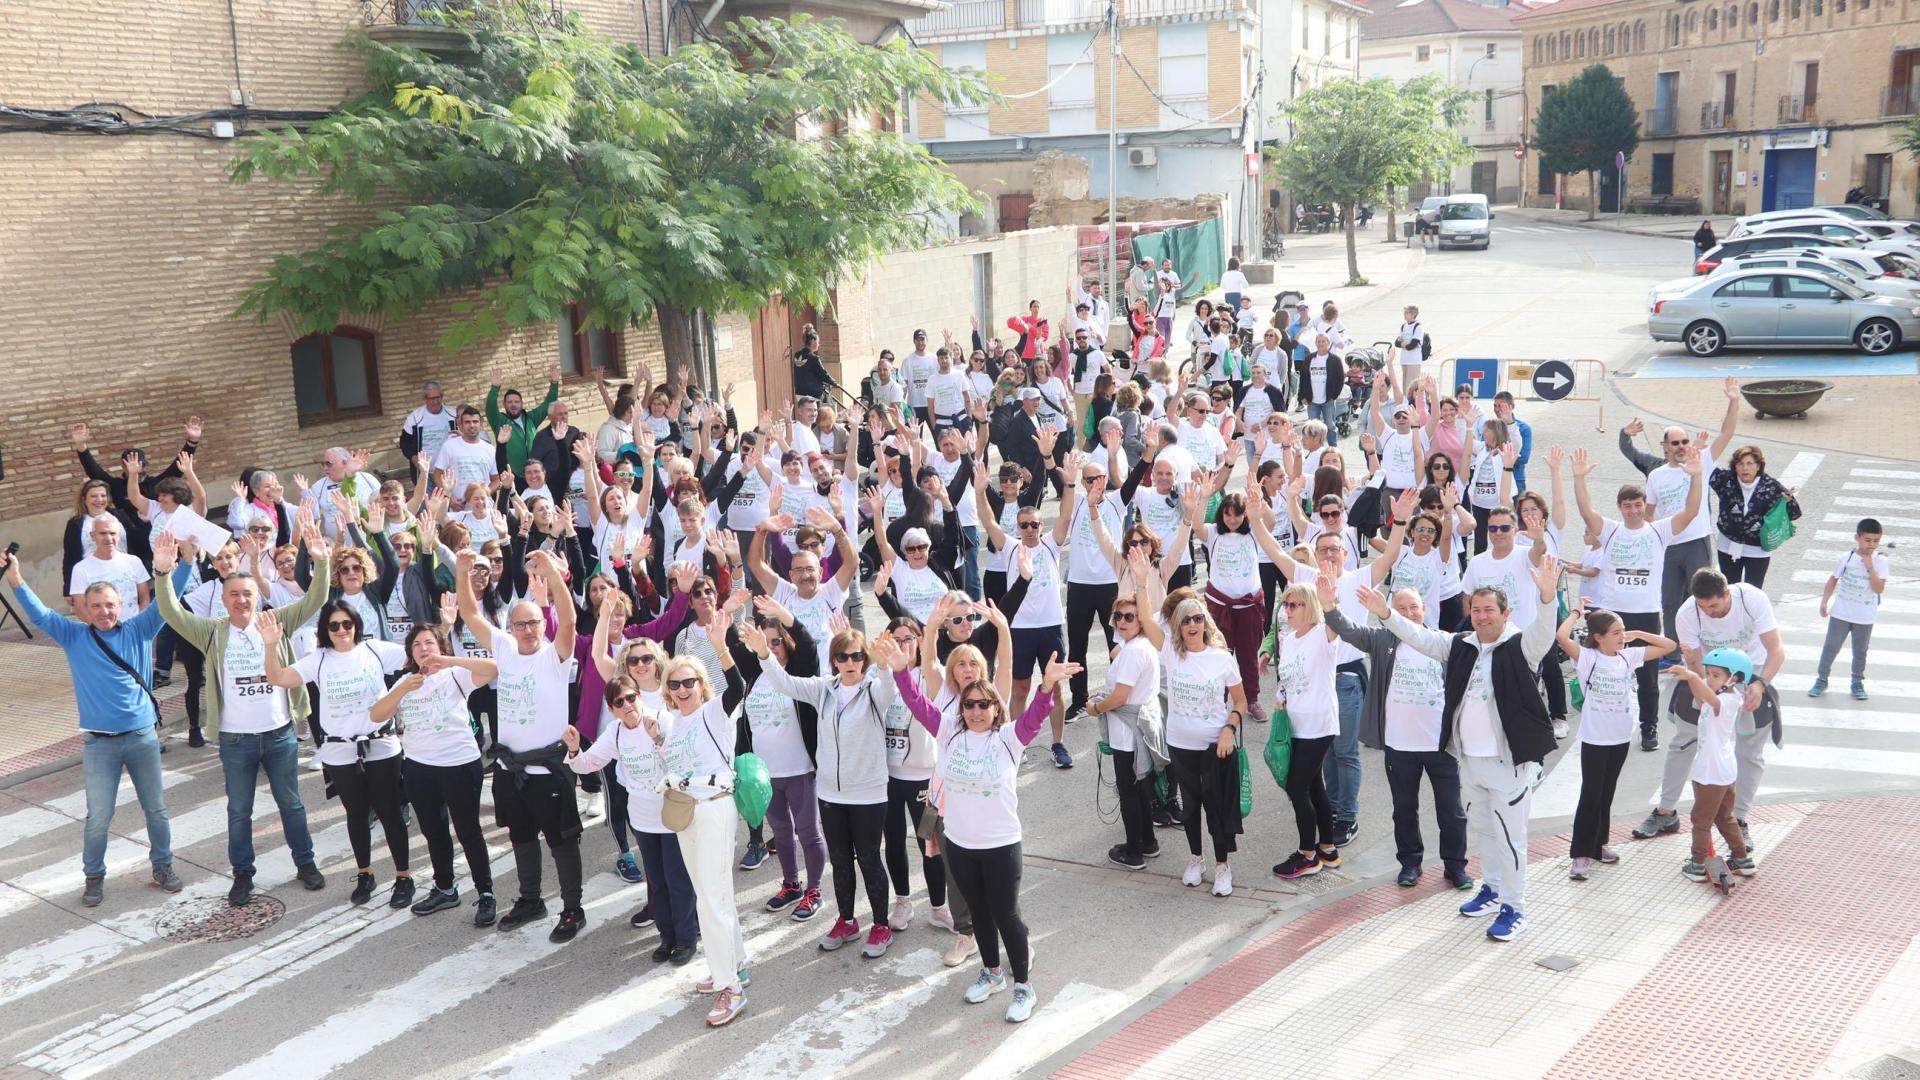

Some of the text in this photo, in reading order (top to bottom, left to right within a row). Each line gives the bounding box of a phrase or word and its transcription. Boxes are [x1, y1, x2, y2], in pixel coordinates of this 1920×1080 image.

[1281, 540, 1290, 548] 34
[1618, 577, 1647, 586] 0156
[466, 650, 494, 658] 153
[238, 684, 274, 697] 2648
[885, 737, 905, 749] 293
